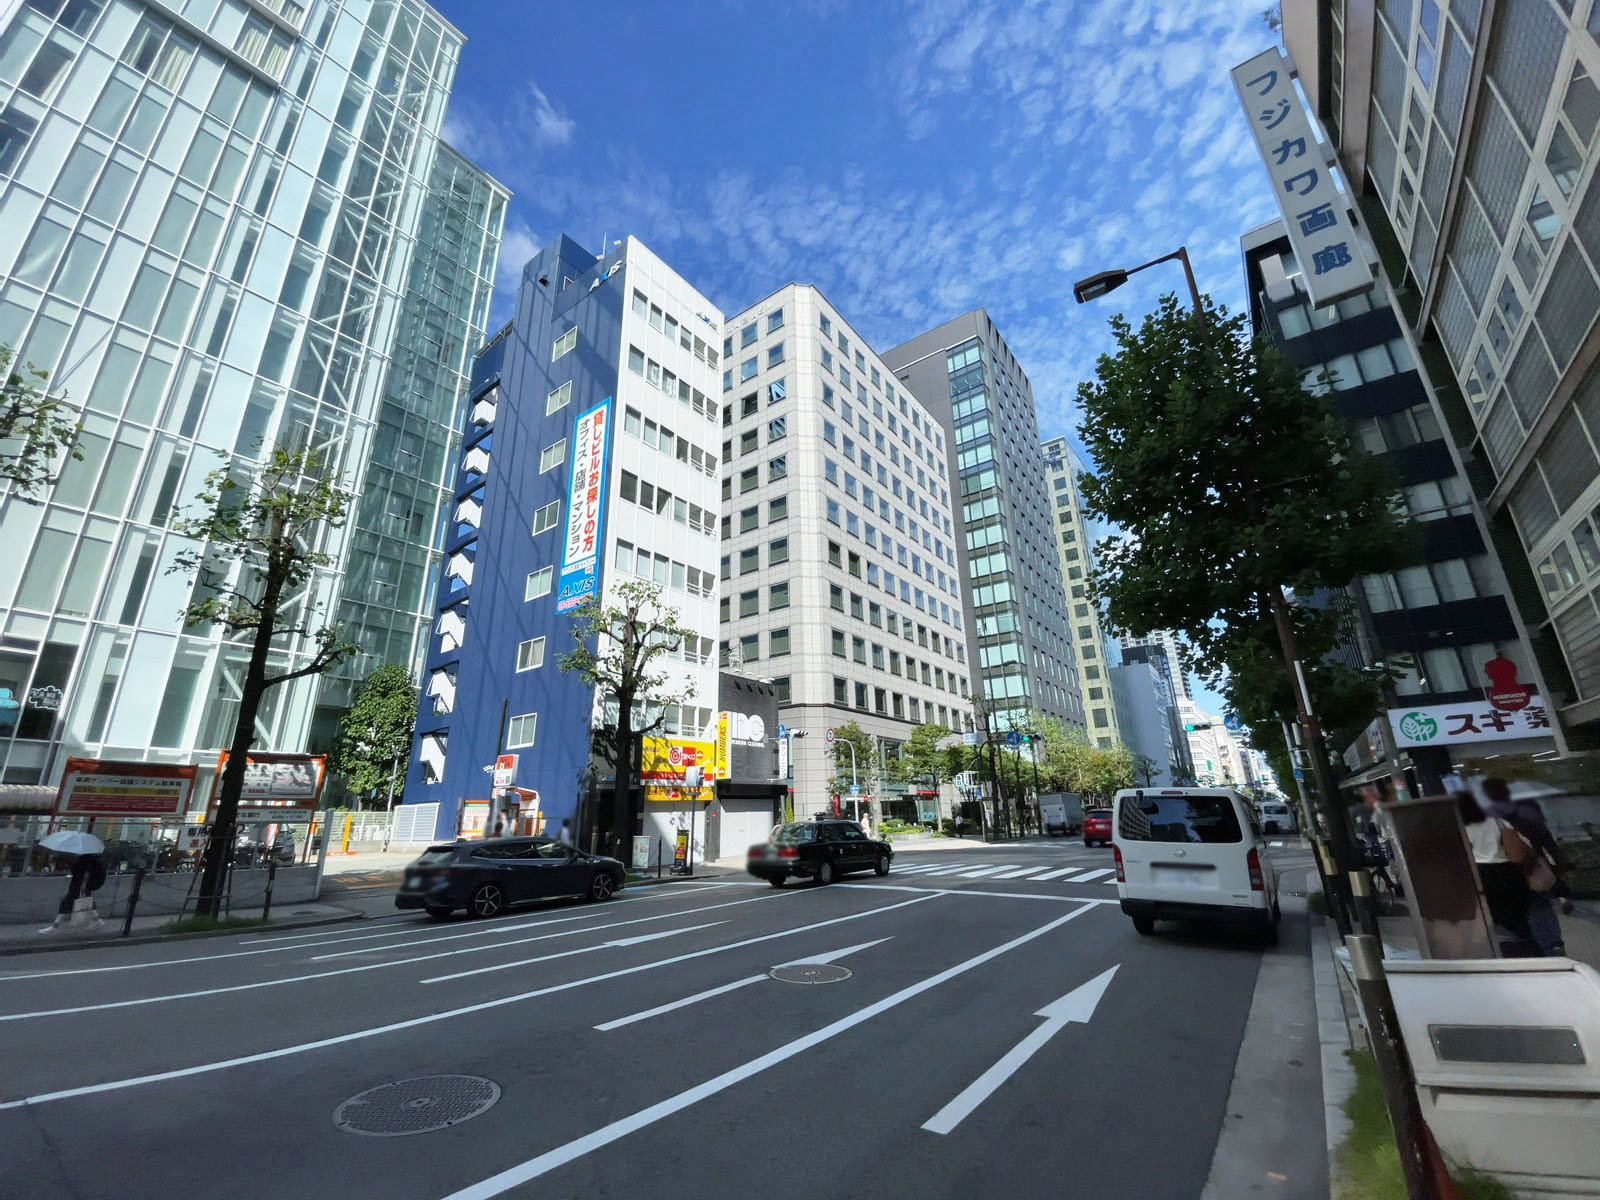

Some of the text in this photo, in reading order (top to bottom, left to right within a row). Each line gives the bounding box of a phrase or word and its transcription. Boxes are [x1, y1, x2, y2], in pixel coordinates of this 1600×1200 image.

[1246, 70, 1353, 276] フジカワ画廊
[589, 259, 623, 292] AXIS
[568, 418, 591, 558] オフィス・店舗・マンション
[582, 409, 605, 553] 貸しビルお探しの方
[559, 576, 596, 599] AXIS
[719, 725, 727, 762] NUMBERS
